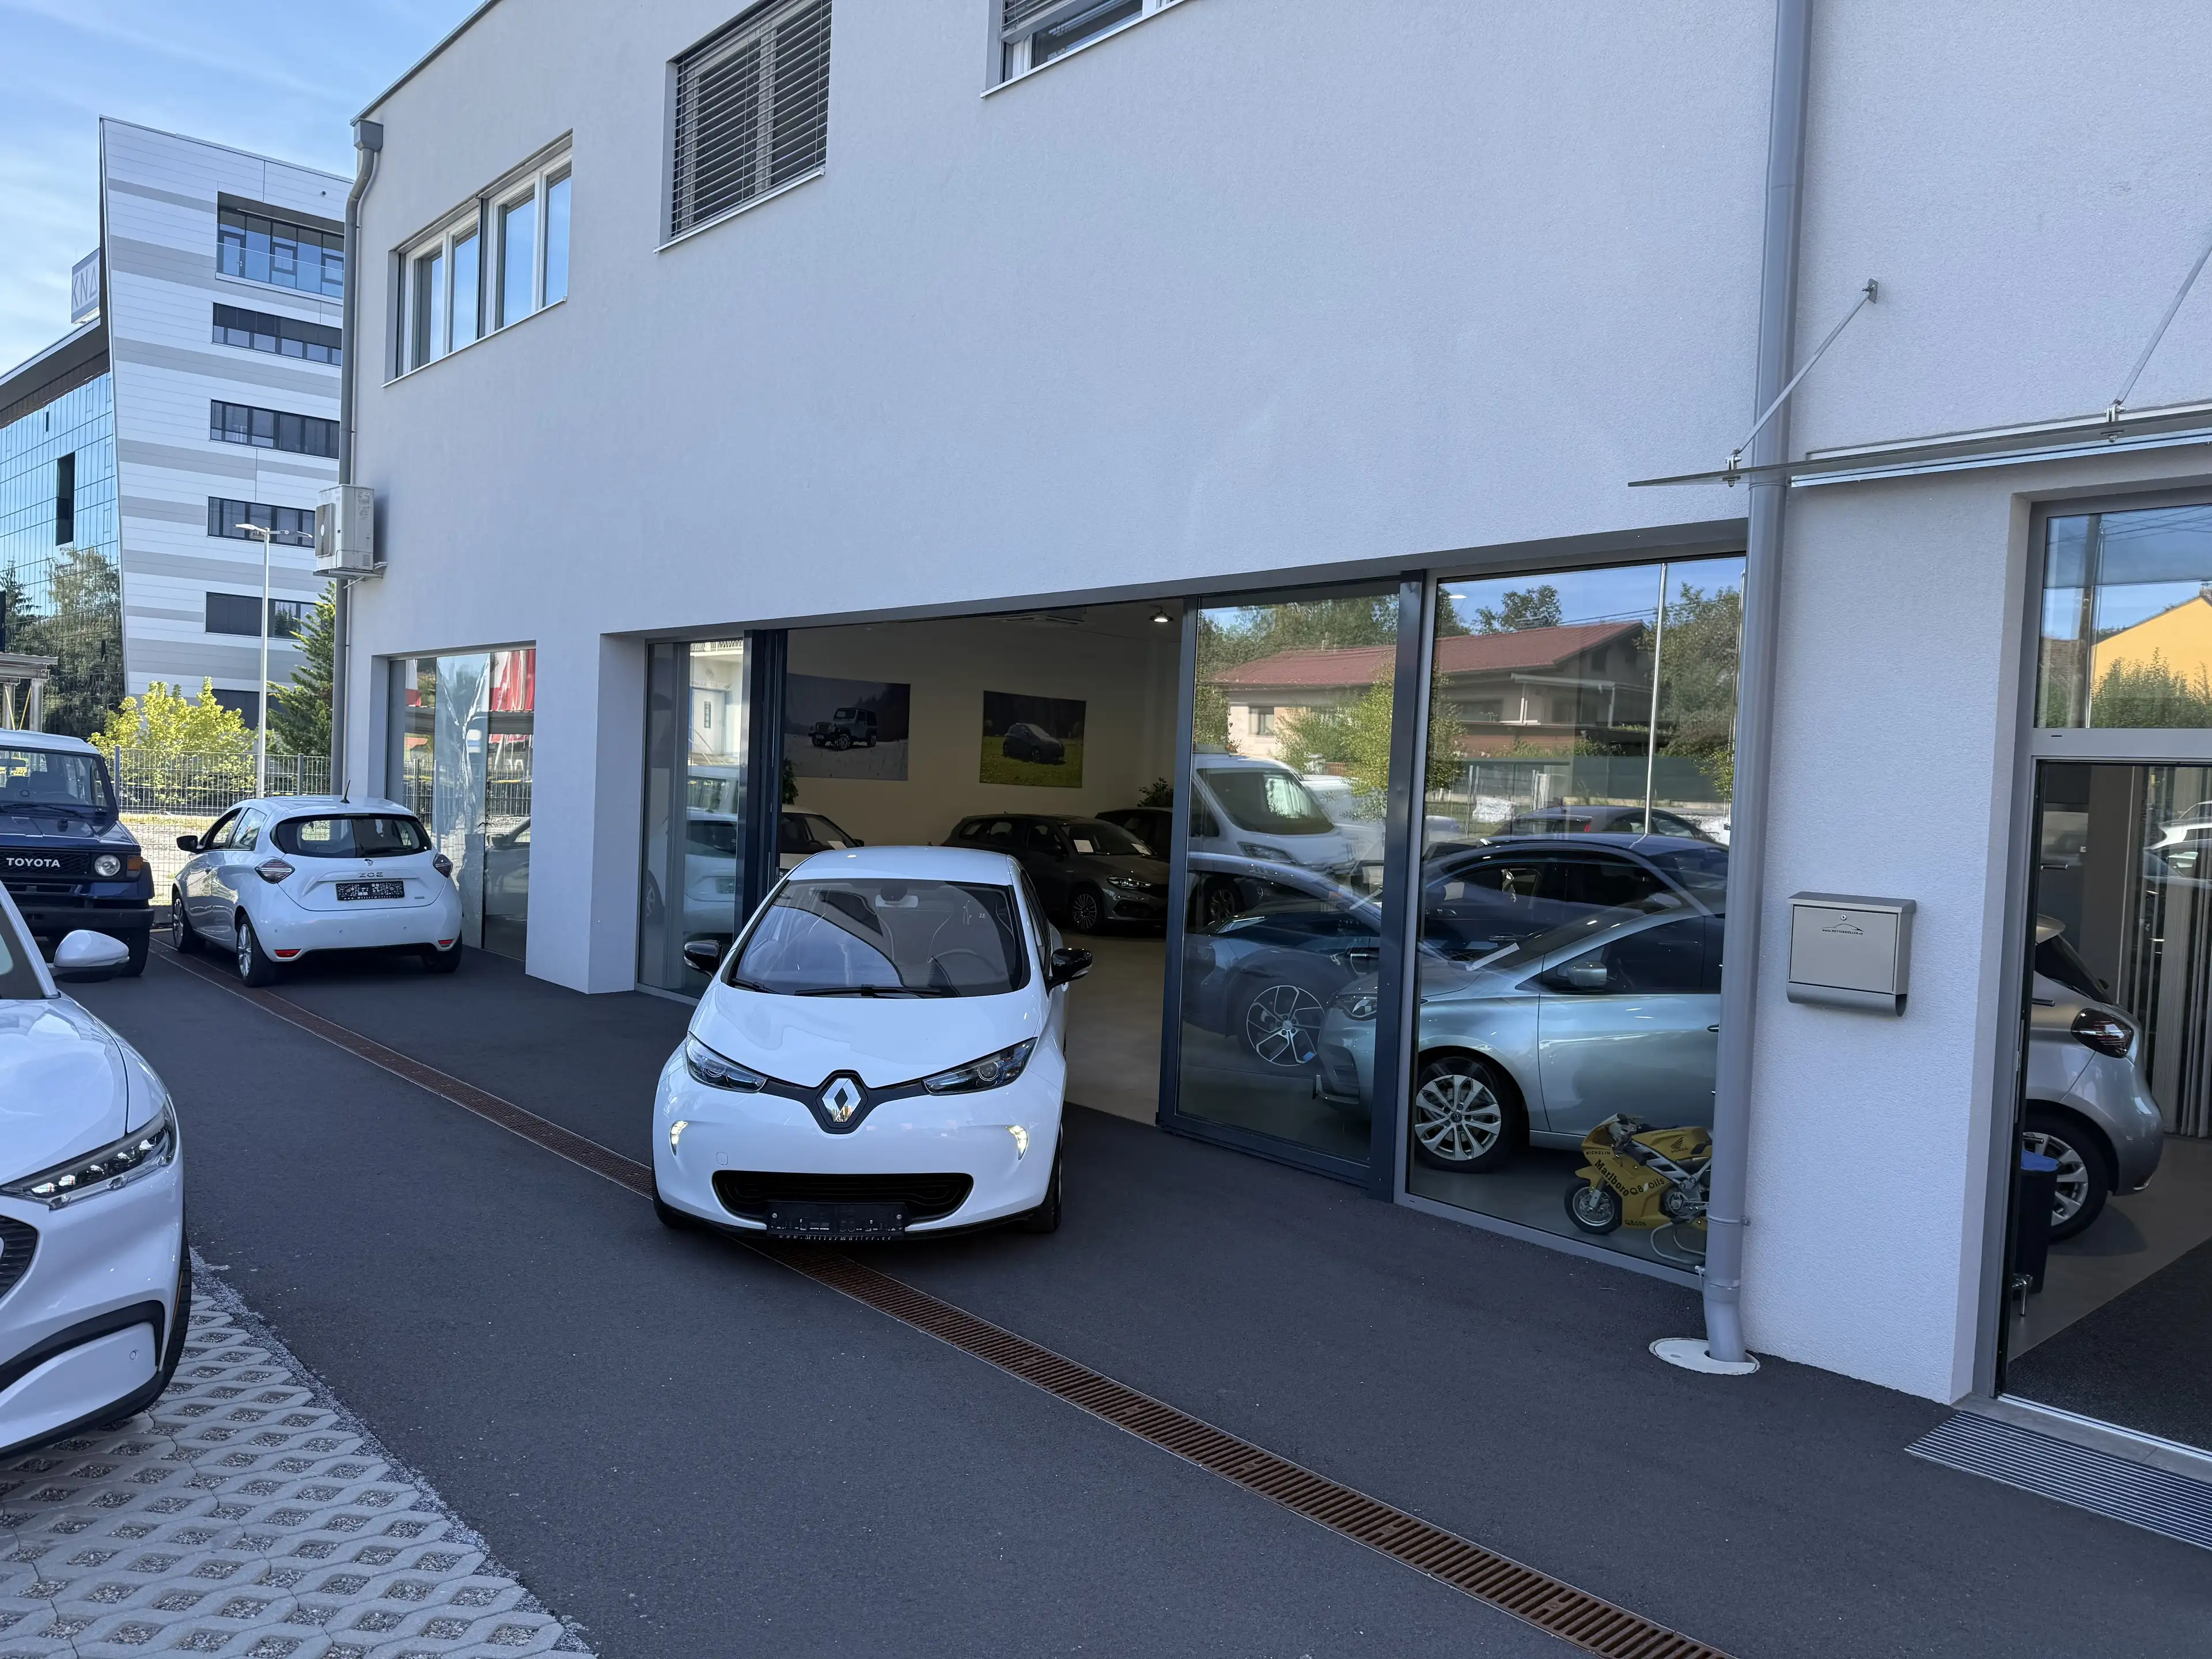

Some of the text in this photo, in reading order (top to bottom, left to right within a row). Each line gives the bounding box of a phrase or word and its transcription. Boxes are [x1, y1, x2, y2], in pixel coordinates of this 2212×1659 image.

[6, 858, 60, 868] TOYOTA
[1594, 1159, 1630, 1196] Marlboro
[1630, 1178, 1665, 1195] Q8 oils
